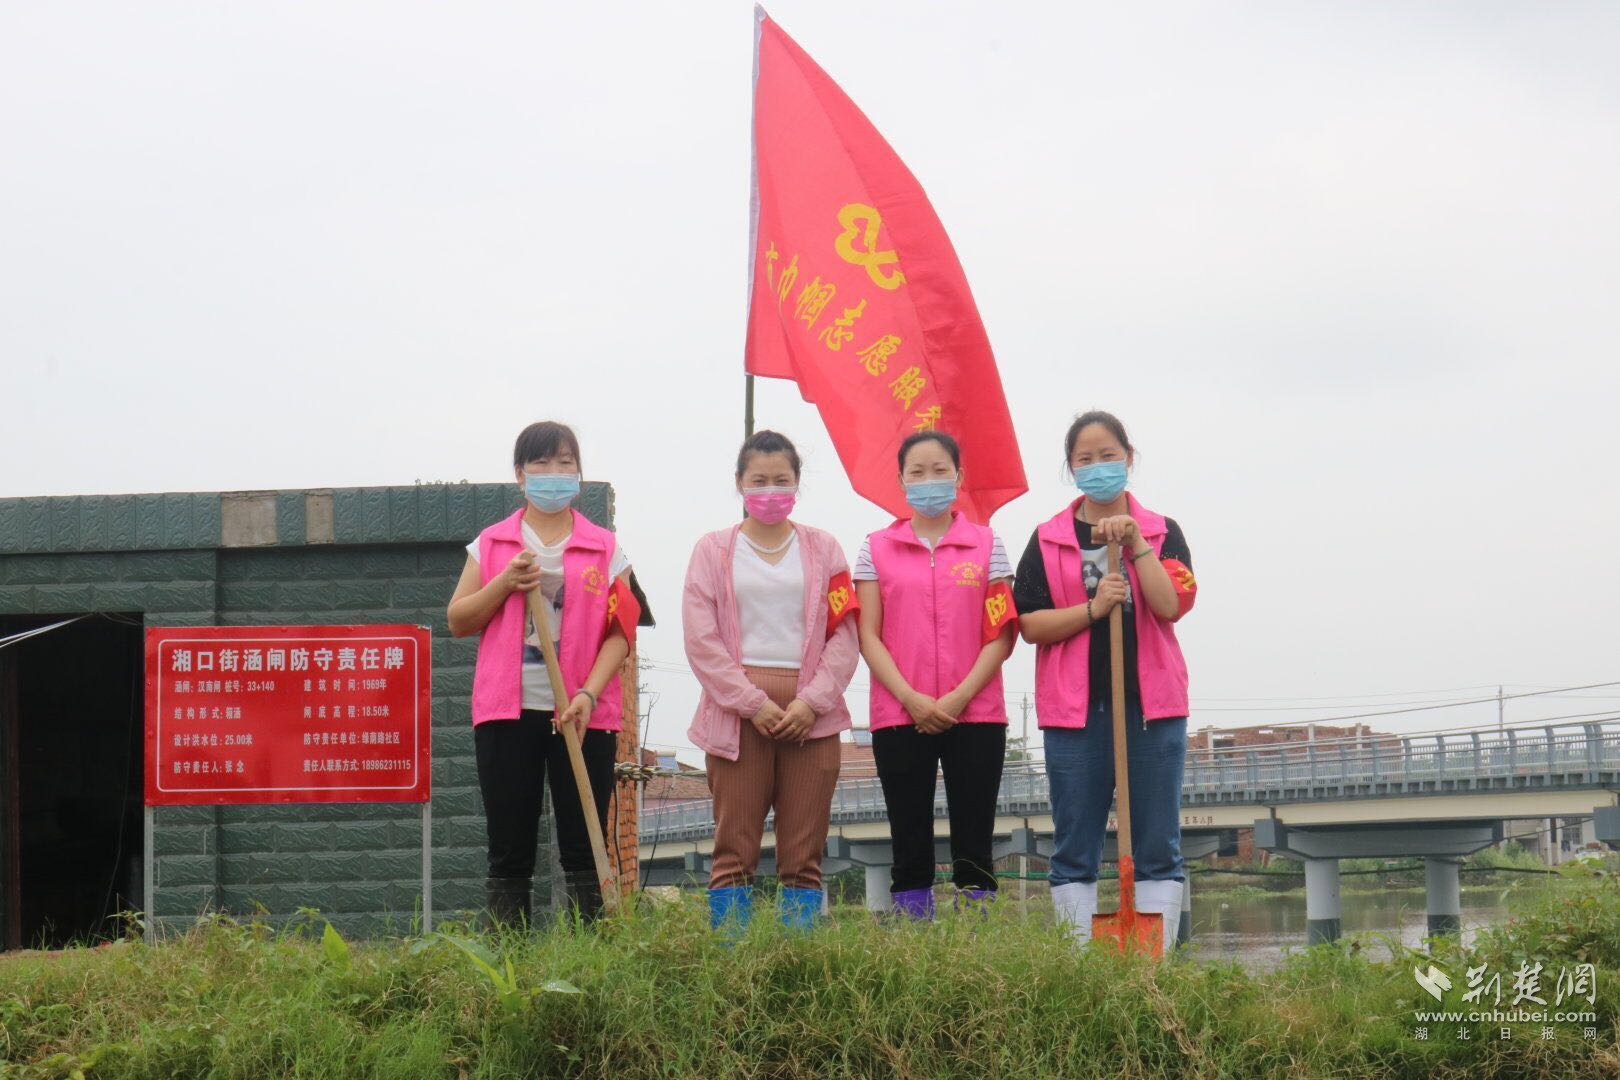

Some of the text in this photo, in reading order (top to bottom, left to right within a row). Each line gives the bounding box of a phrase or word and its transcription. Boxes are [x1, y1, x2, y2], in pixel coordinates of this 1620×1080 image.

[171, 646, 405, 672] 湘口街涵闸防守责任牌
